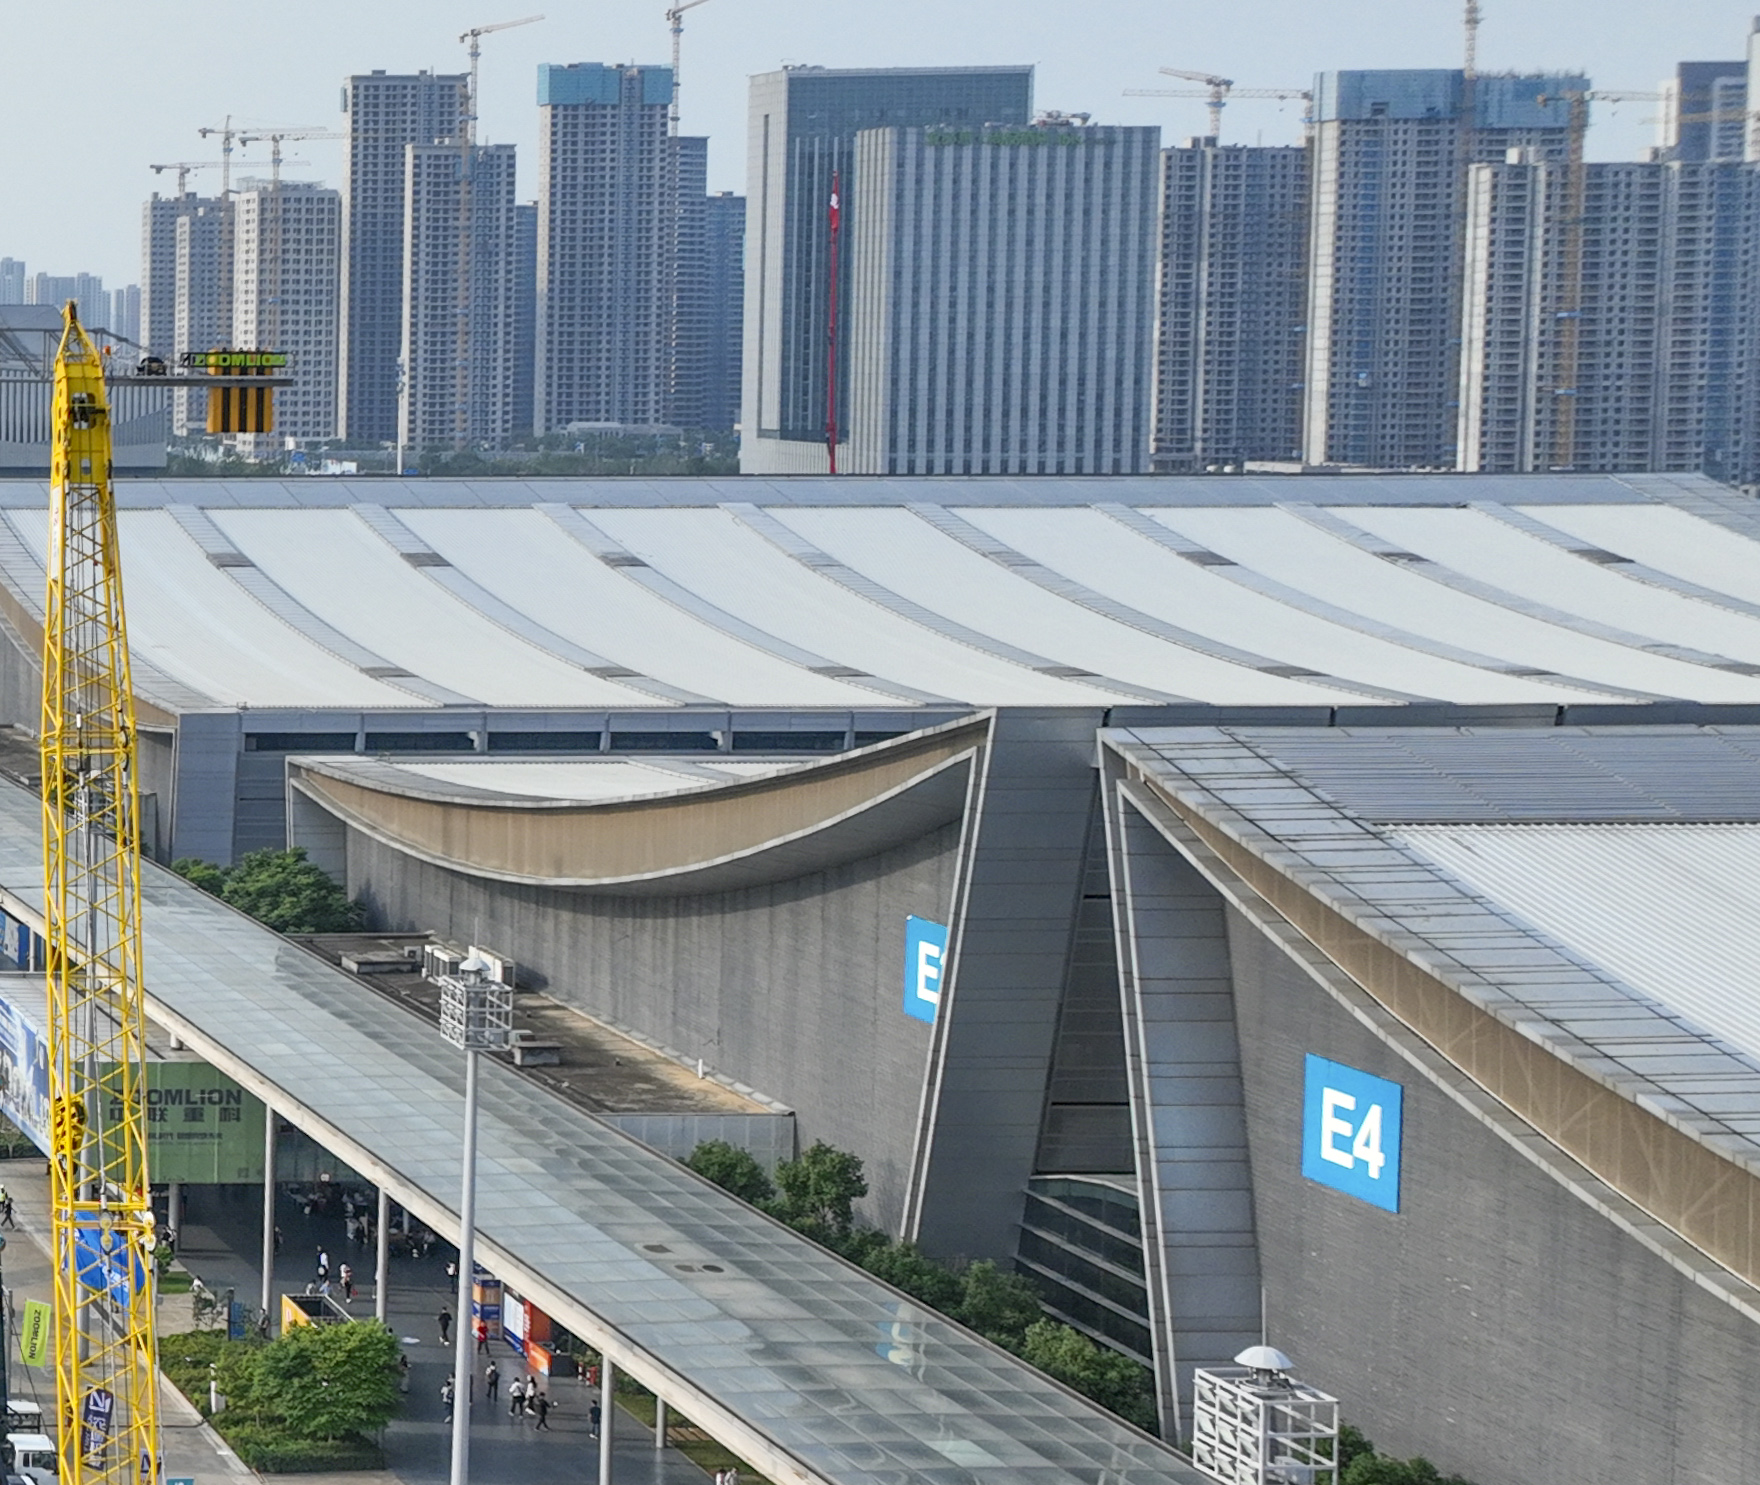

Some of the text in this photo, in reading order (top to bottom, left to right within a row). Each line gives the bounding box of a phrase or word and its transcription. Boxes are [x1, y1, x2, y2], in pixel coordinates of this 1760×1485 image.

[194, 353, 286, 367] ZOOMLION
[916, 940, 944, 1003] E
[1320, 1086, 1385, 1178] E4
[28, 1309, 42, 1359] ZOOMLION
